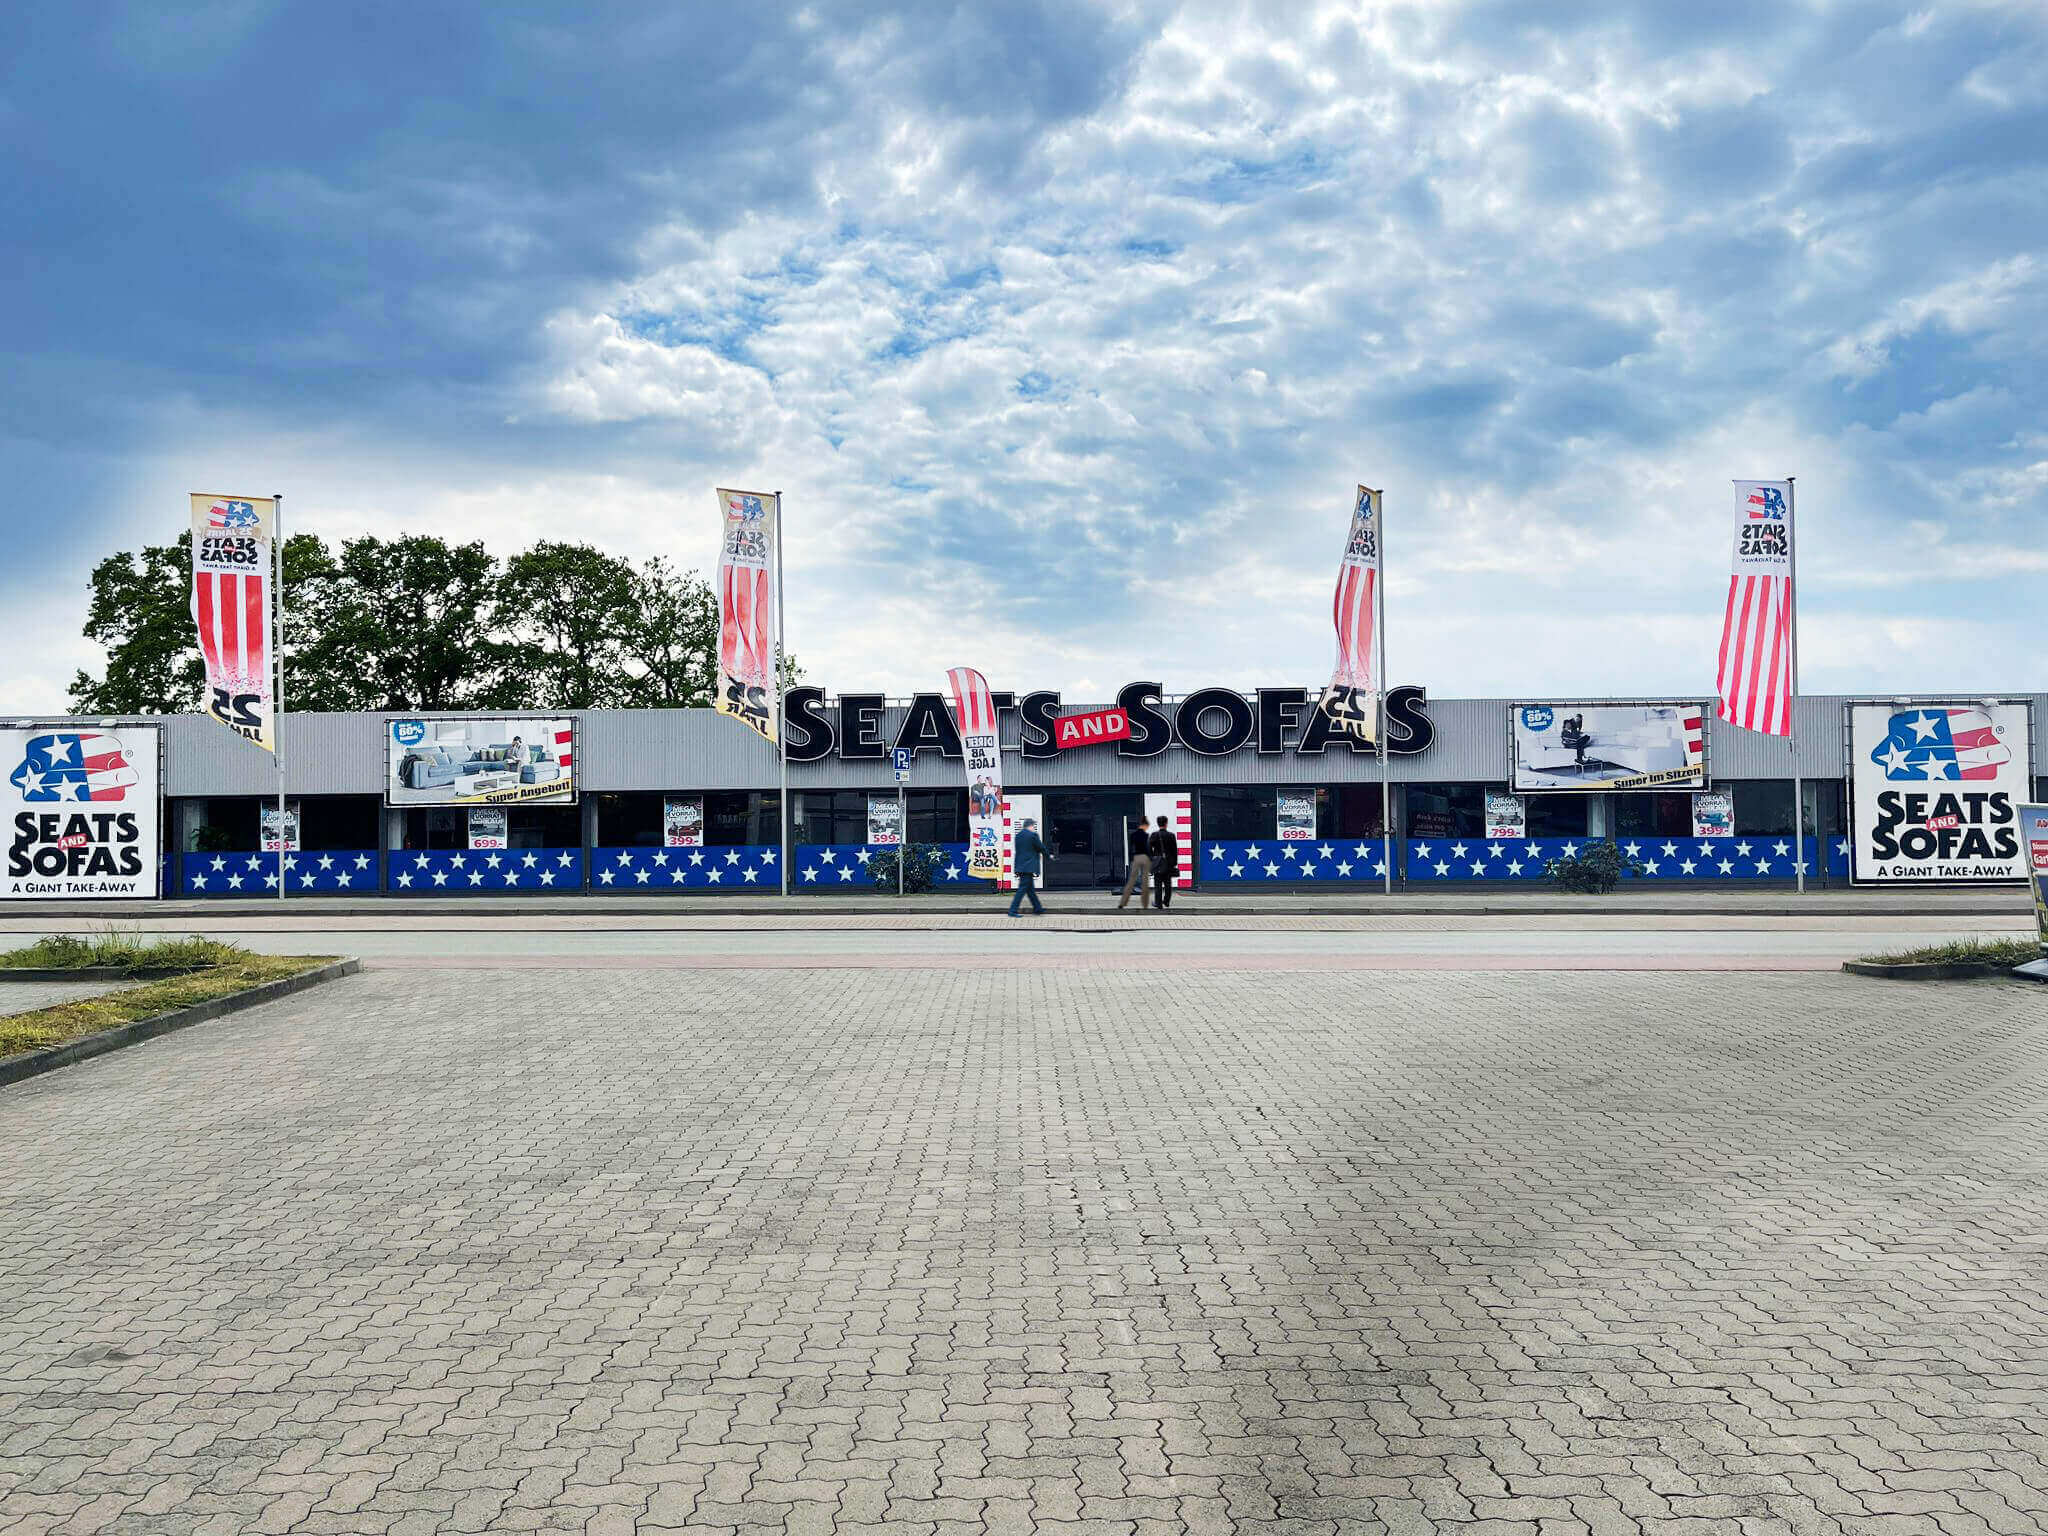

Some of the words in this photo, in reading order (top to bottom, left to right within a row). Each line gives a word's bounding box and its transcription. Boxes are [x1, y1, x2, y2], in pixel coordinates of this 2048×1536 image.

[1061, 713, 1125, 741] AND
[1116, 681, 1436, 757] SOFAS
[1527, 711, 1552, 723] 60%
[398, 725, 423, 737] 60%
[897, 750, 907, 767] P
[1613, 776, 1648, 789] Super
[1666, 767, 1702, 781] Sitzen
[485, 790, 518, 803] Super
[1877, 790, 2014, 826] SEATS
[14, 811, 139, 845] SEATS
[1928, 815, 1957, 829] AND
[60, 835, 86, 849] AND
[1871, 827, 2019, 861] SOFAS
[8, 845, 143, 878] SOFAS
[1877, 866, 1888, 877] A
[1892, 865, 1934, 876] GIANT
[1937, 865, 2013, 877] TAKE-AWAY
[12, 883, 21, 893] A
[25, 882, 62, 894] GIANT
[66, 882, 137, 893] TAKE-AWAY
